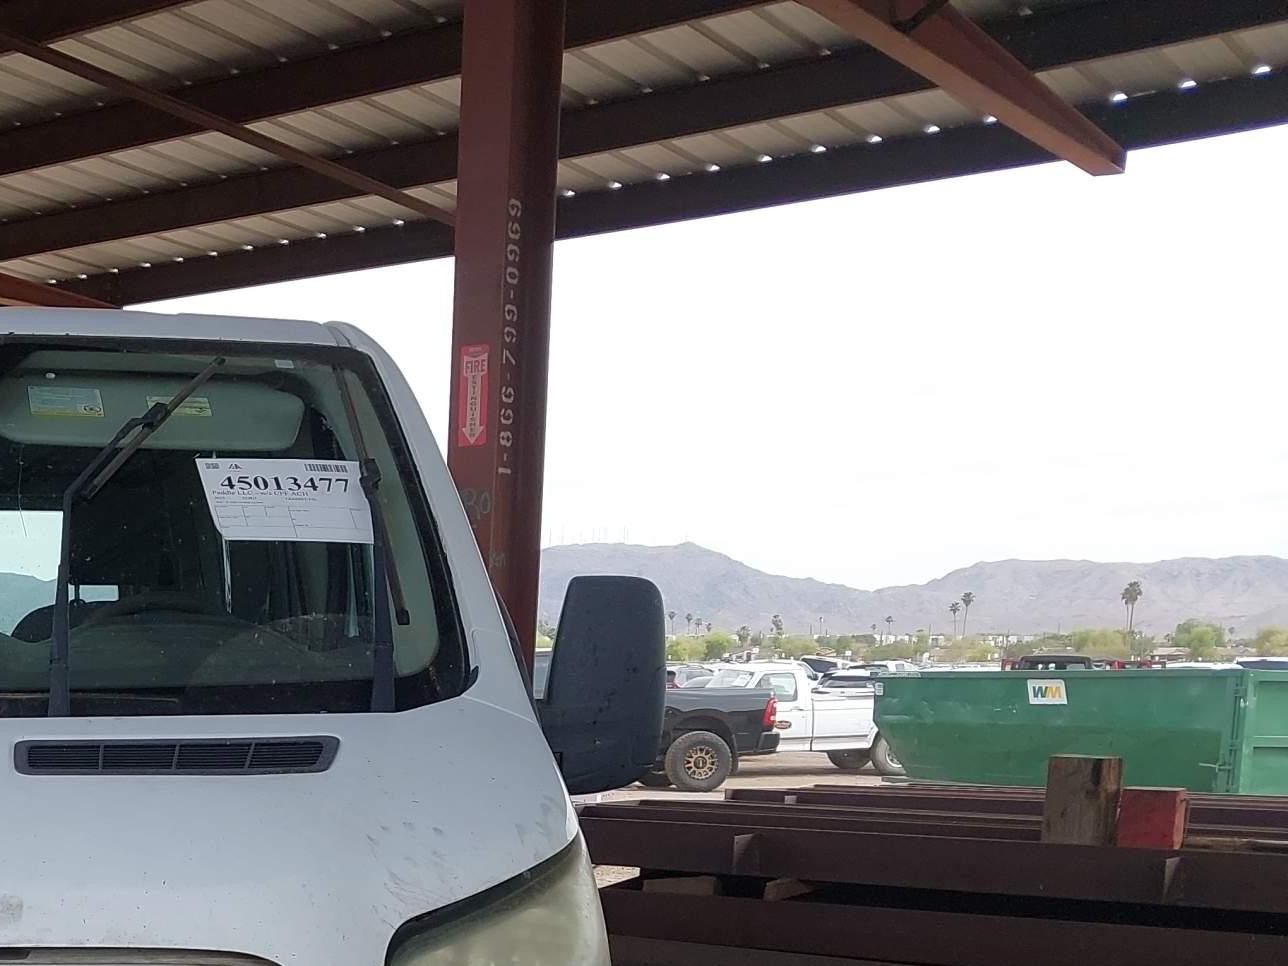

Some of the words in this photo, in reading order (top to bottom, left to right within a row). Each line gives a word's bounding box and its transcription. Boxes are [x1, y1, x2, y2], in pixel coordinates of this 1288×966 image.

[498, 198, 521, 475] 1-866-799-0969
[465, 359, 486, 373] FIRE
[220, 475, 349, 492] 45013477
[1032, 685, 1061, 699] WM
